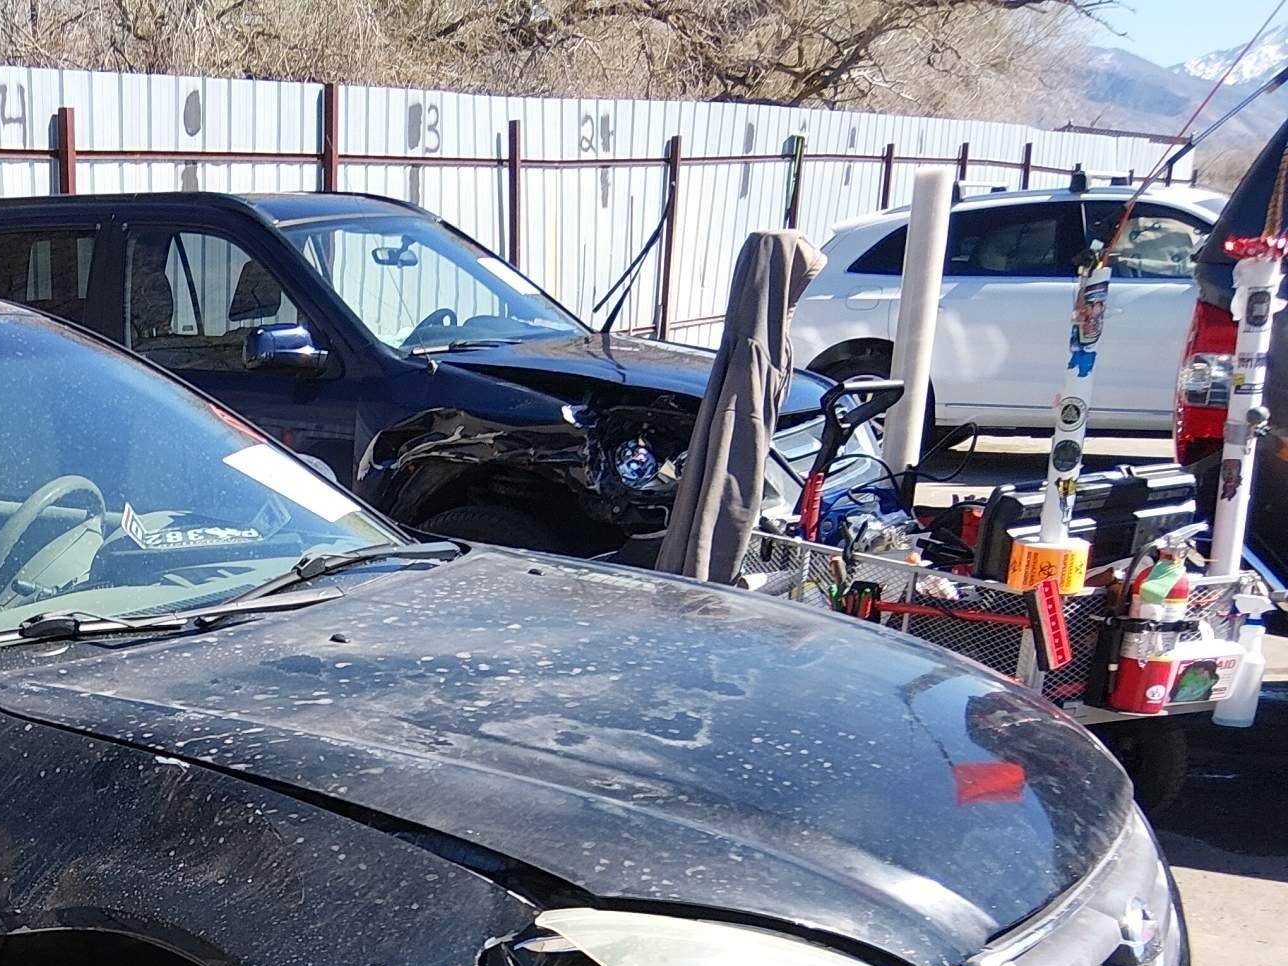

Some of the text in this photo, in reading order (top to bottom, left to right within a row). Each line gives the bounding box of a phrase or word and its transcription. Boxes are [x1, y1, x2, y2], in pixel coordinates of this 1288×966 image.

[0, 82, 27, 149] 4
[425, 104, 440, 153] 3
[580, 114, 598, 154] 2
